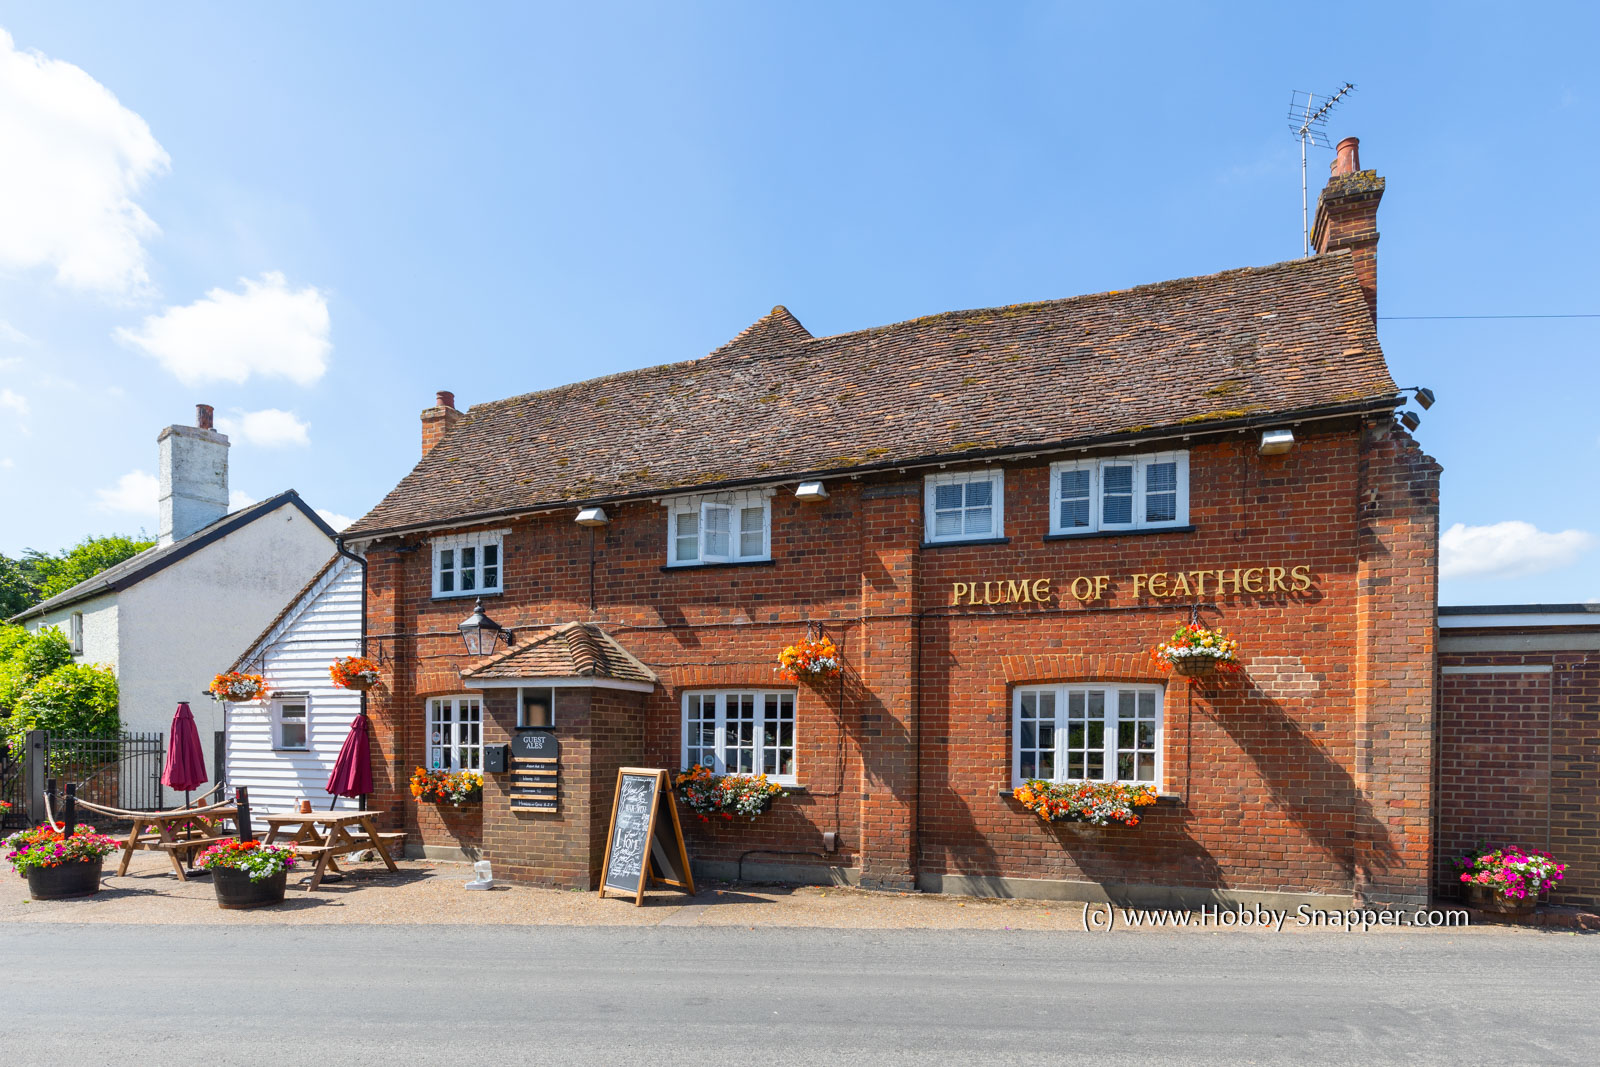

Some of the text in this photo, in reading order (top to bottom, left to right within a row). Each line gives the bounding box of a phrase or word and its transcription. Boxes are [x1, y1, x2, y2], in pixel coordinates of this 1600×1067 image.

[952, 564, 1311, 606] PLUME OF FEATHERS
[522, 736, 547, 744] GUEST
